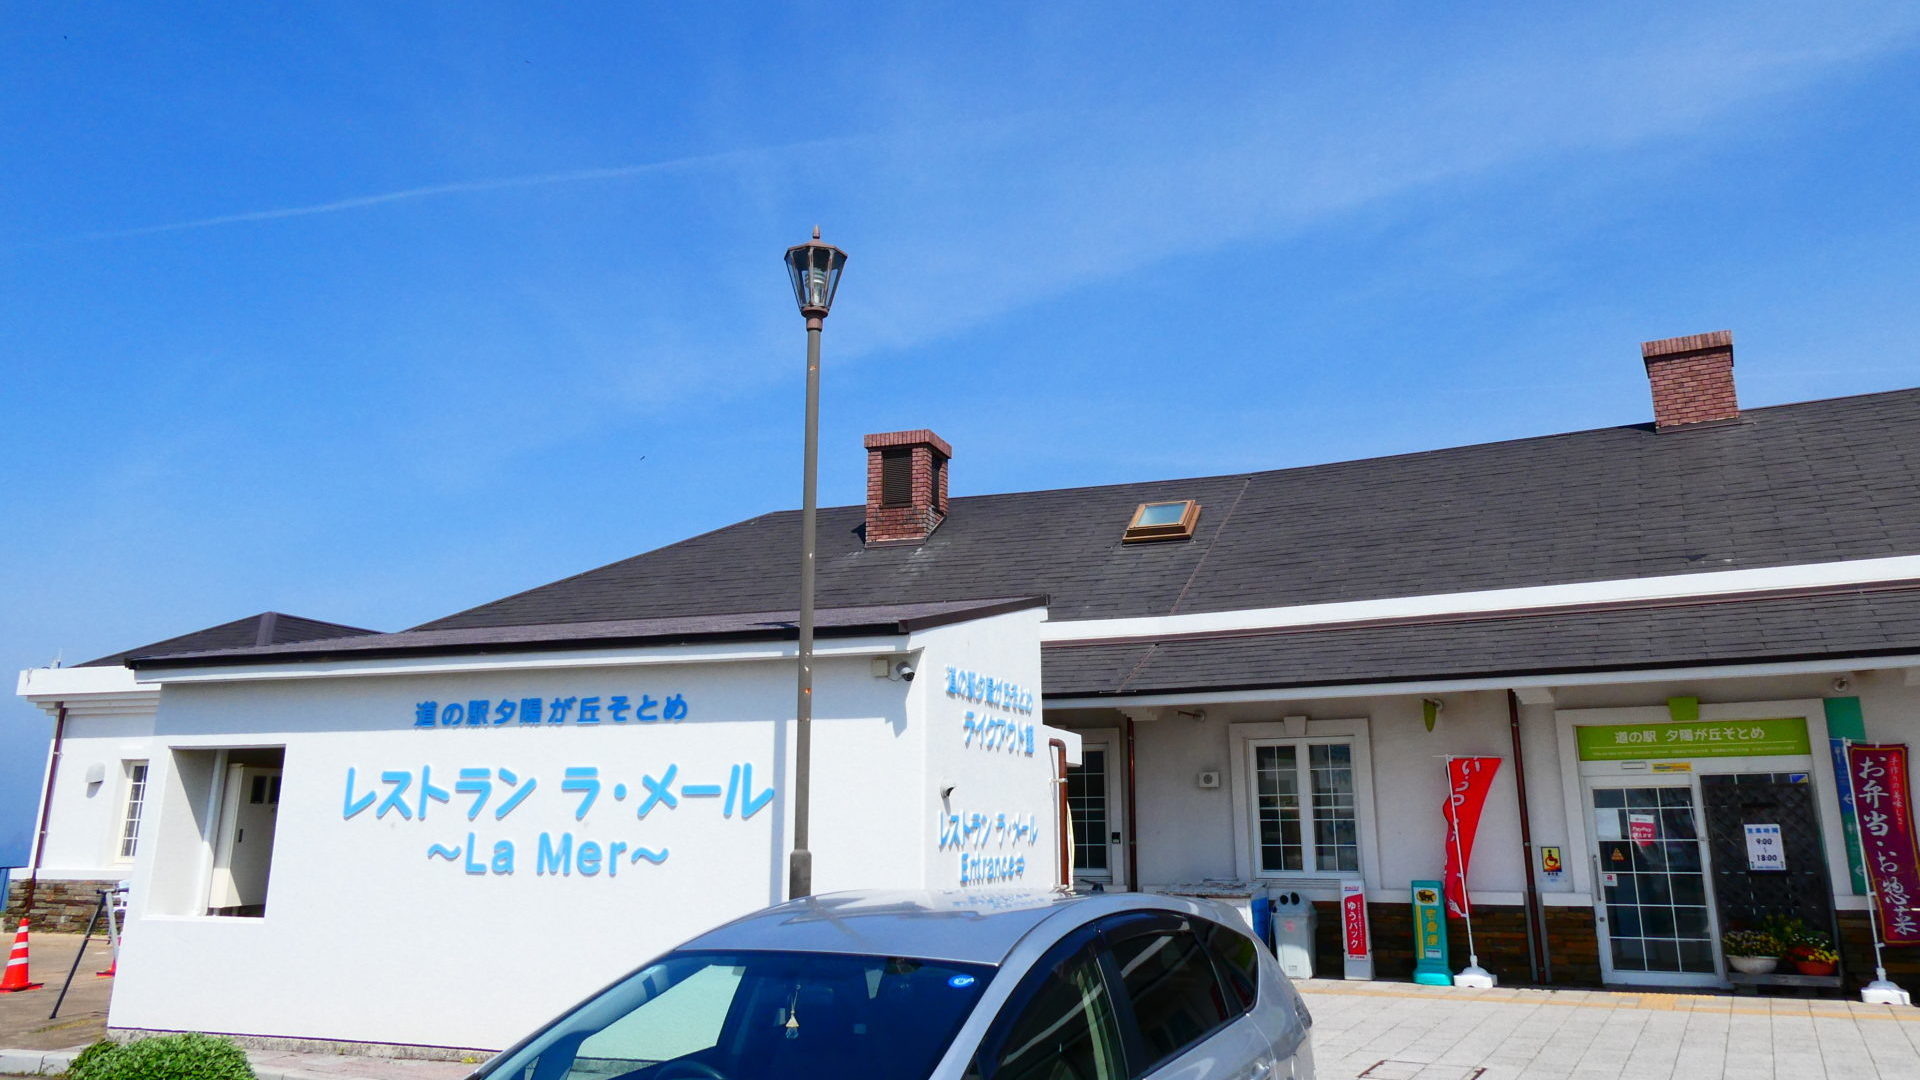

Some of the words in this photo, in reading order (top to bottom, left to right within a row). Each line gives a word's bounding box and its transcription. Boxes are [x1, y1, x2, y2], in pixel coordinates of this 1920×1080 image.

[414, 693, 689, 728] 道の駅夕陽が丘そとめ
[1614, 729, 1657, 745] 道の駅
[1665, 727, 1765, 743] 夕陽が丘そとめ
[343, 764, 538, 820] レストラン
[561, 762, 776, 820] ラ・メール
[939, 810, 993, 852] レストラン
[995, 812, 1039, 848] ラ・メール
[1858, 755, 1919, 936] お弁当・お惣菜
[960, 852, 1015, 887] Entrance
[1756, 854, 1778, 862] 18:00
